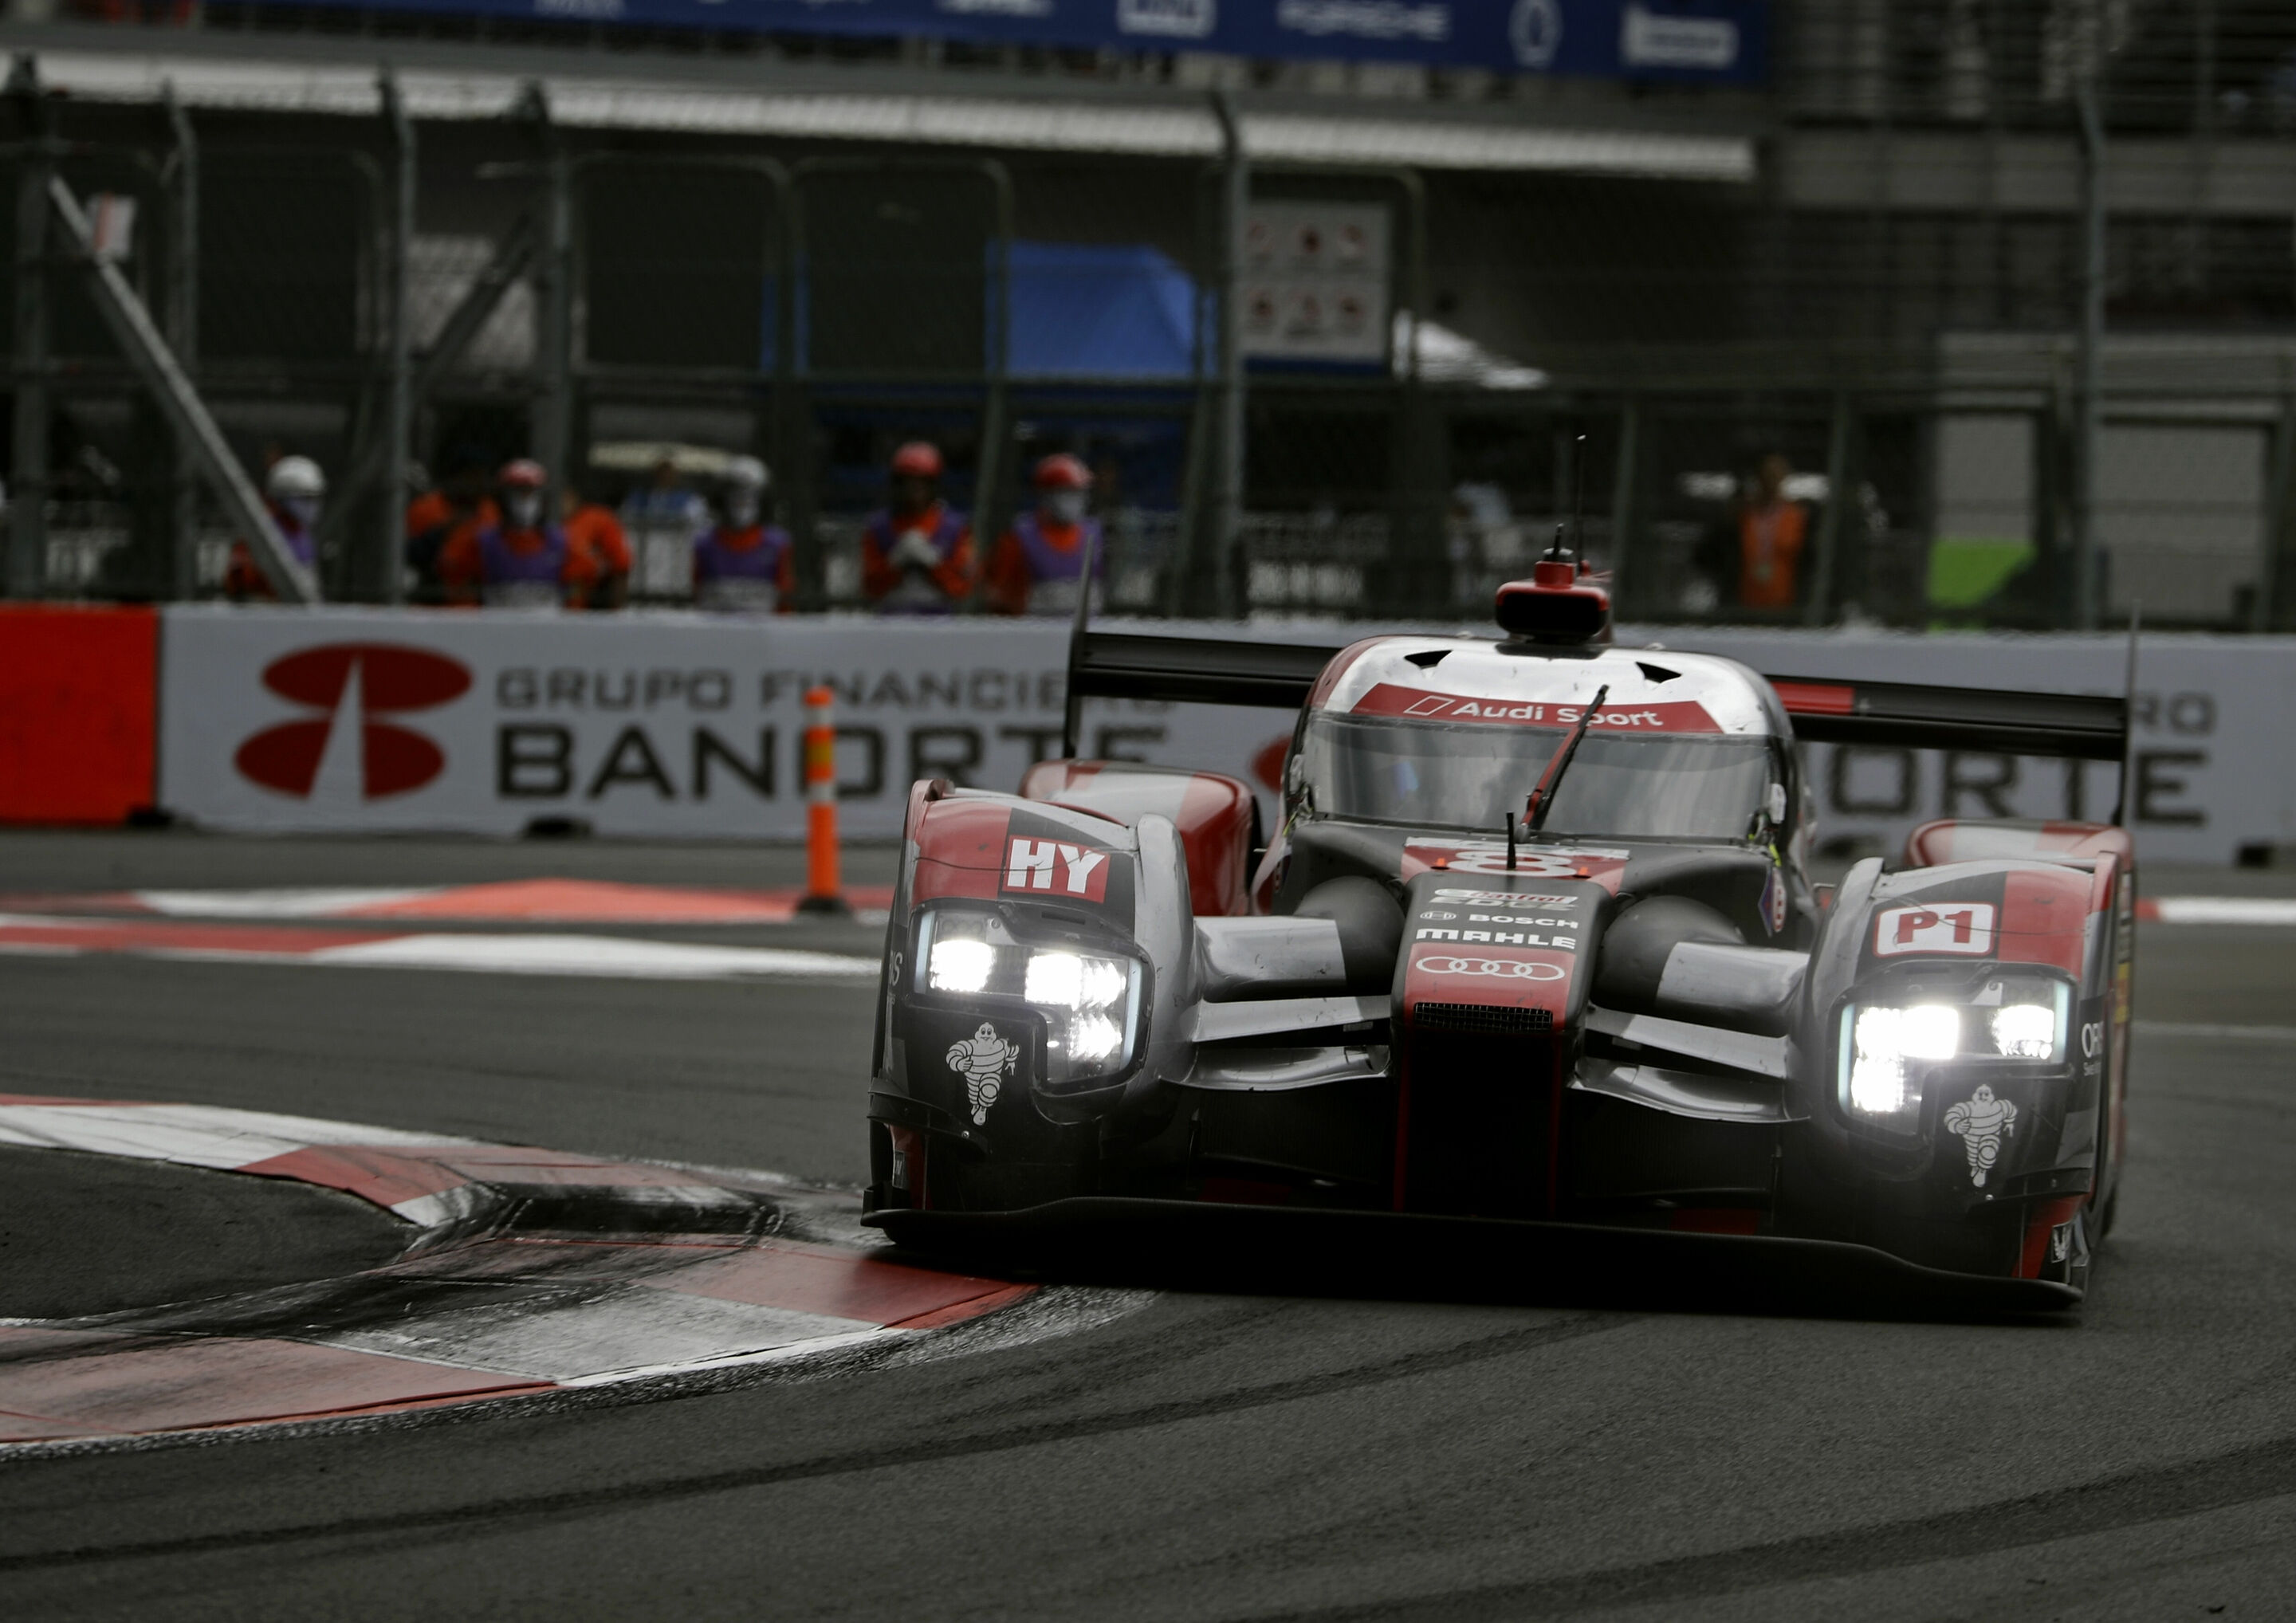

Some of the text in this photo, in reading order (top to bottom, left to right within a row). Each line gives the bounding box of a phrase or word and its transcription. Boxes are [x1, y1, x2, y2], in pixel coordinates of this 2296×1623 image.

[495, 666, 1170, 713] GRUPO FINANCIE
[1451, 701, 1664, 727] Audi Sport
[496, 722, 1166, 800] BANORTE
[1007, 839, 1106, 894] HY
[1446, 851, 1578, 877] 8
[1428, 897, 1580, 911] EDGE
[1470, 890, 1566, 903] Castrol
[1468, 914, 1579, 929] BOSCH
[1897, 910, 1973, 944] P1
[1416, 928, 1577, 949] MAHLE
